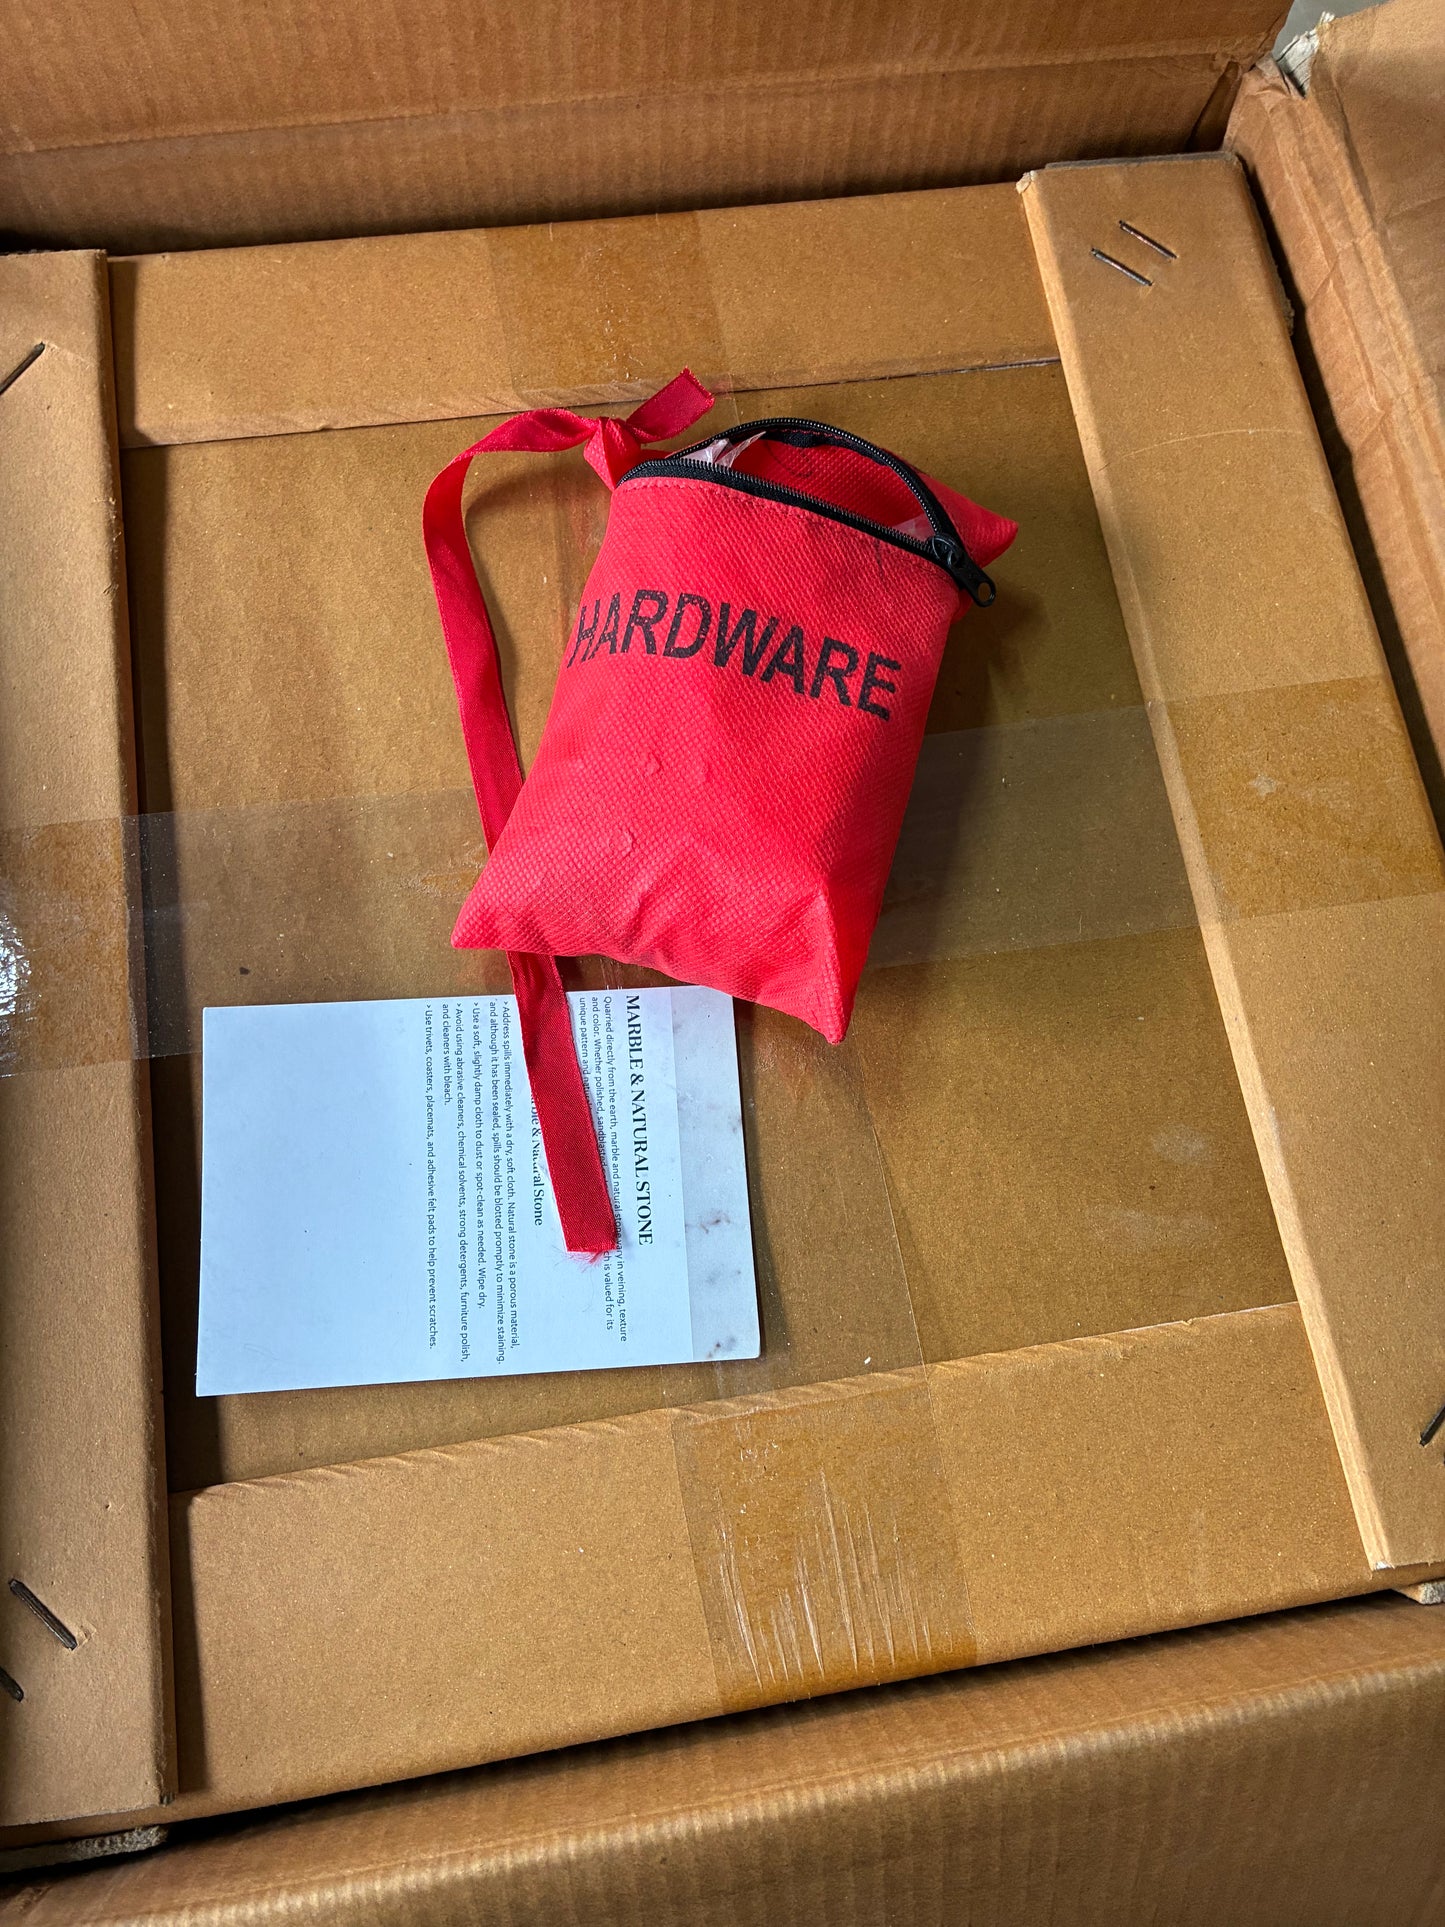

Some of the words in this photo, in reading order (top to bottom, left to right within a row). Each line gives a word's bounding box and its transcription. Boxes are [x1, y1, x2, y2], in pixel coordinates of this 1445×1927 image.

[567, 588, 901, 721] HARDWARE
[424, 1009, 432, 1026] Use
[442, 1003, 451, 1020] and
[472, 1007, 480, 1024] Use
[489, 1001, 498, 1018] and
[577, 997, 587, 1026] unique
[591, 996, 600, 1013] and
[602, 995, 614, 1033] Quarried
[455, 1008, 464, 1033] Avoid
[502, 1006, 510, 1040] Address
[592, 1013, 601, 1038] color.
[625, 995, 643, 1070] MARBLE
[424, 1026, 433, 1056] trivets,
[442, 1020, 451, 1056] cleaners
[454, 1033, 464, 1056] using
[472, 1030, 482, 1050] soft,
[488, 1018, 499, 1056] although
[501, 1039, 511, 1061] spills
[578, 1027, 588, 1058] pattern
[605, 1033, 615, 1066] directly
[443, 1055, 452, 1075] with
[471, 1050, 482, 1081] slightly
[491, 1063, 499, 1079] has
[580, 1059, 591, 1076] and
[593, 1038, 603, 1075] Whether
[425, 1056, 433, 1094] coasters,
[456, 1056, 465, 1091] abrasive
[503, 1061, 513, 1113] immediately
[607, 1066, 616, 1088] from
[630, 1073, 644, 1087] &
[443, 1075, 453, 1106] bleach.
[472, 1081, 483, 1106] damp
[491, 1079, 499, 1101] been
[593, 1076, 605, 1115] polished,
[608, 1088, 617, 1104] the
[424, 1094, 435, 1140] placemats,
[456, 1091, 466, 1130] cleaners,
[474, 1106, 483, 1129] cloth
[491, 1101, 501, 1131] sealed,
[505, 1112, 514, 1132] with
[609, 1104, 618, 1130] earth,
[490, 1132, 501, 1154] spills
[504, 1139, 514, 1156] dry,
[532, 1127, 542, 1138] &
[596, 1115, 608, 1168] sandblasted
[610, 1131, 620, 1162] marble
[630, 1089, 648, 1178] NATURAL
[426, 1141, 436, 1158] and
[457, 1130, 467, 1169] chemical
[475, 1140, 484, 1160] dust
[427, 1158, 436, 1197] adhesive
[493, 1154, 502, 1184] should
[506, 1156, 515, 1175] soft
[610, 1163, 620, 1181] and
[457, 1169, 467, 1208] solvents,
[474, 1171, 485, 1218] spot-clean
[506, 1175, 516, 1201] cloth.
[612, 1181, 622, 1213] natural
[427, 1197, 437, 1213] felt
[494, 1197, 503, 1230] blotted
[507, 1201, 517, 1234] Natural
[534, 1188, 545, 1226] Stone
[635, 1181, 653, 1246] STONE
[425, 1213, 437, 1235] pads
[457, 1209, 466, 1238] strong
[614, 1212, 624, 1239] stone
[426, 1247, 437, 1268] help
[477, 1229, 487, 1267] needed.
[493, 1231, 504, 1272] promptly
[614, 1238, 625, 1261] vary
[457, 1239, 468, 1291] detergents,
[476, 1267, 486, 1291] Wipe
[426, 1268, 436, 1304] prevent
[476, 1291, 487, 1309] dry.
[507, 1277, 516, 1309] porous
[604, 1272, 614, 1302] valued
[616, 1270, 626, 1307] veining,
[460, 1291, 469, 1331] furniture
[496, 1284, 505, 1325] minimize
[605, 1303, 614, 1318] for
[428, 1304, 438, 1350] scratches.
[509, 1309, 520, 1349] material,
[606, 1319, 614, 1331] its
[618, 1308, 627, 1342] texture
[459, 1332, 470, 1363] polish,
[495, 1325, 506, 1365] staining.
